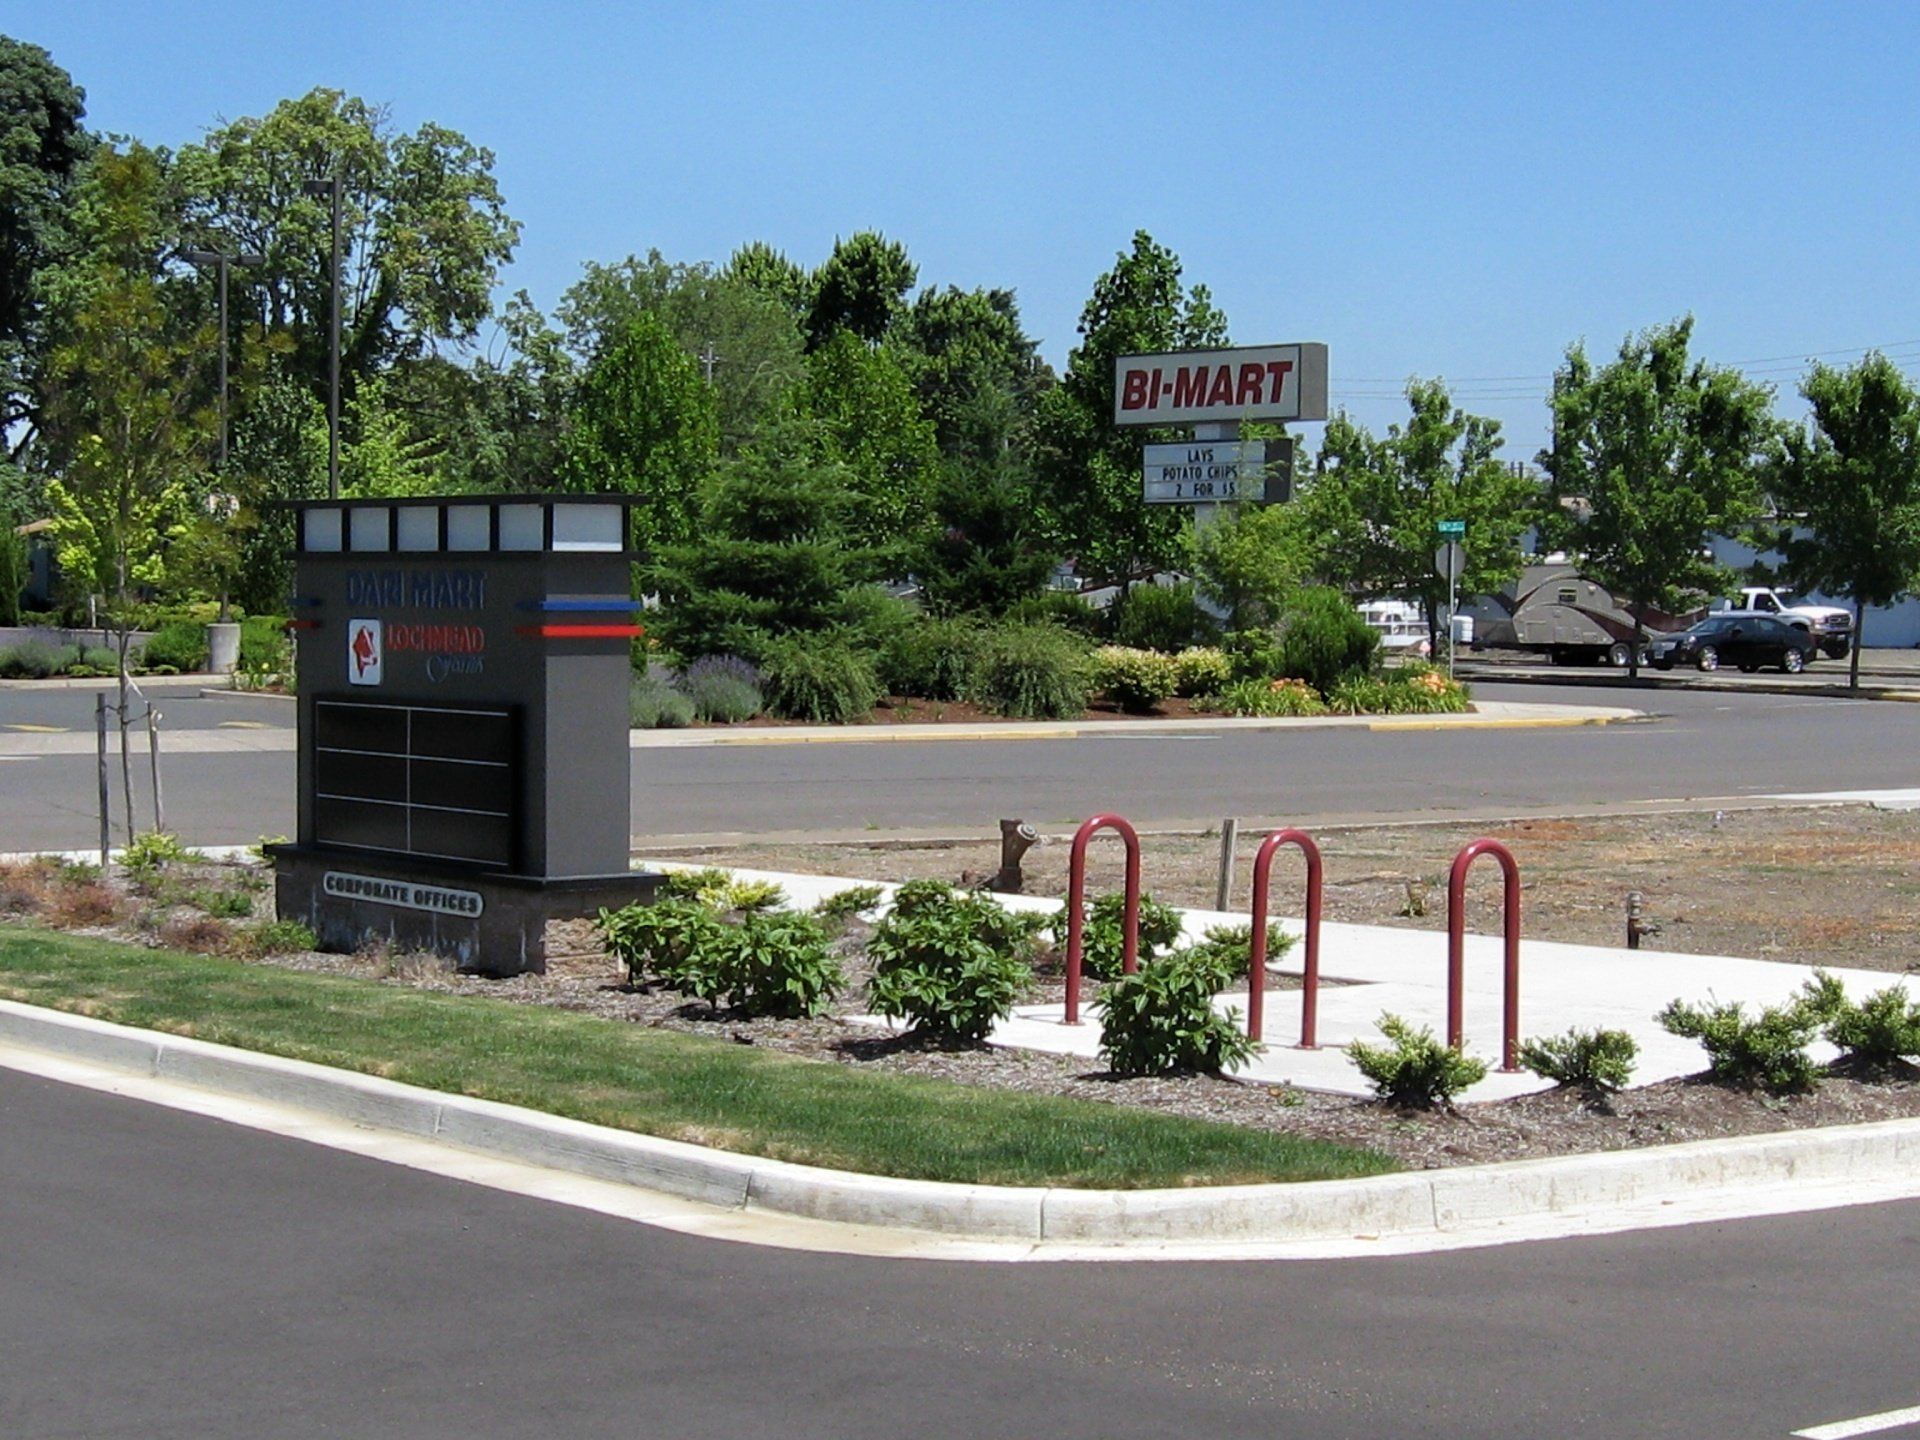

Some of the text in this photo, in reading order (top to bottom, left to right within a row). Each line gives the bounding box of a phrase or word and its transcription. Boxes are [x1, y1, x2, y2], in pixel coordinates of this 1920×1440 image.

[1121, 361, 1293, 410] BI-MART
[1187, 449, 1214, 463] LAYS
[1162, 465, 1238, 480] POTATO CHIPS
[1176, 483, 1182, 497] 2
[1193, 482, 1214, 497] FOR
[346, 570, 487, 609] DARI MART
[326, 875, 478, 913] CORPORATE OFFICES
